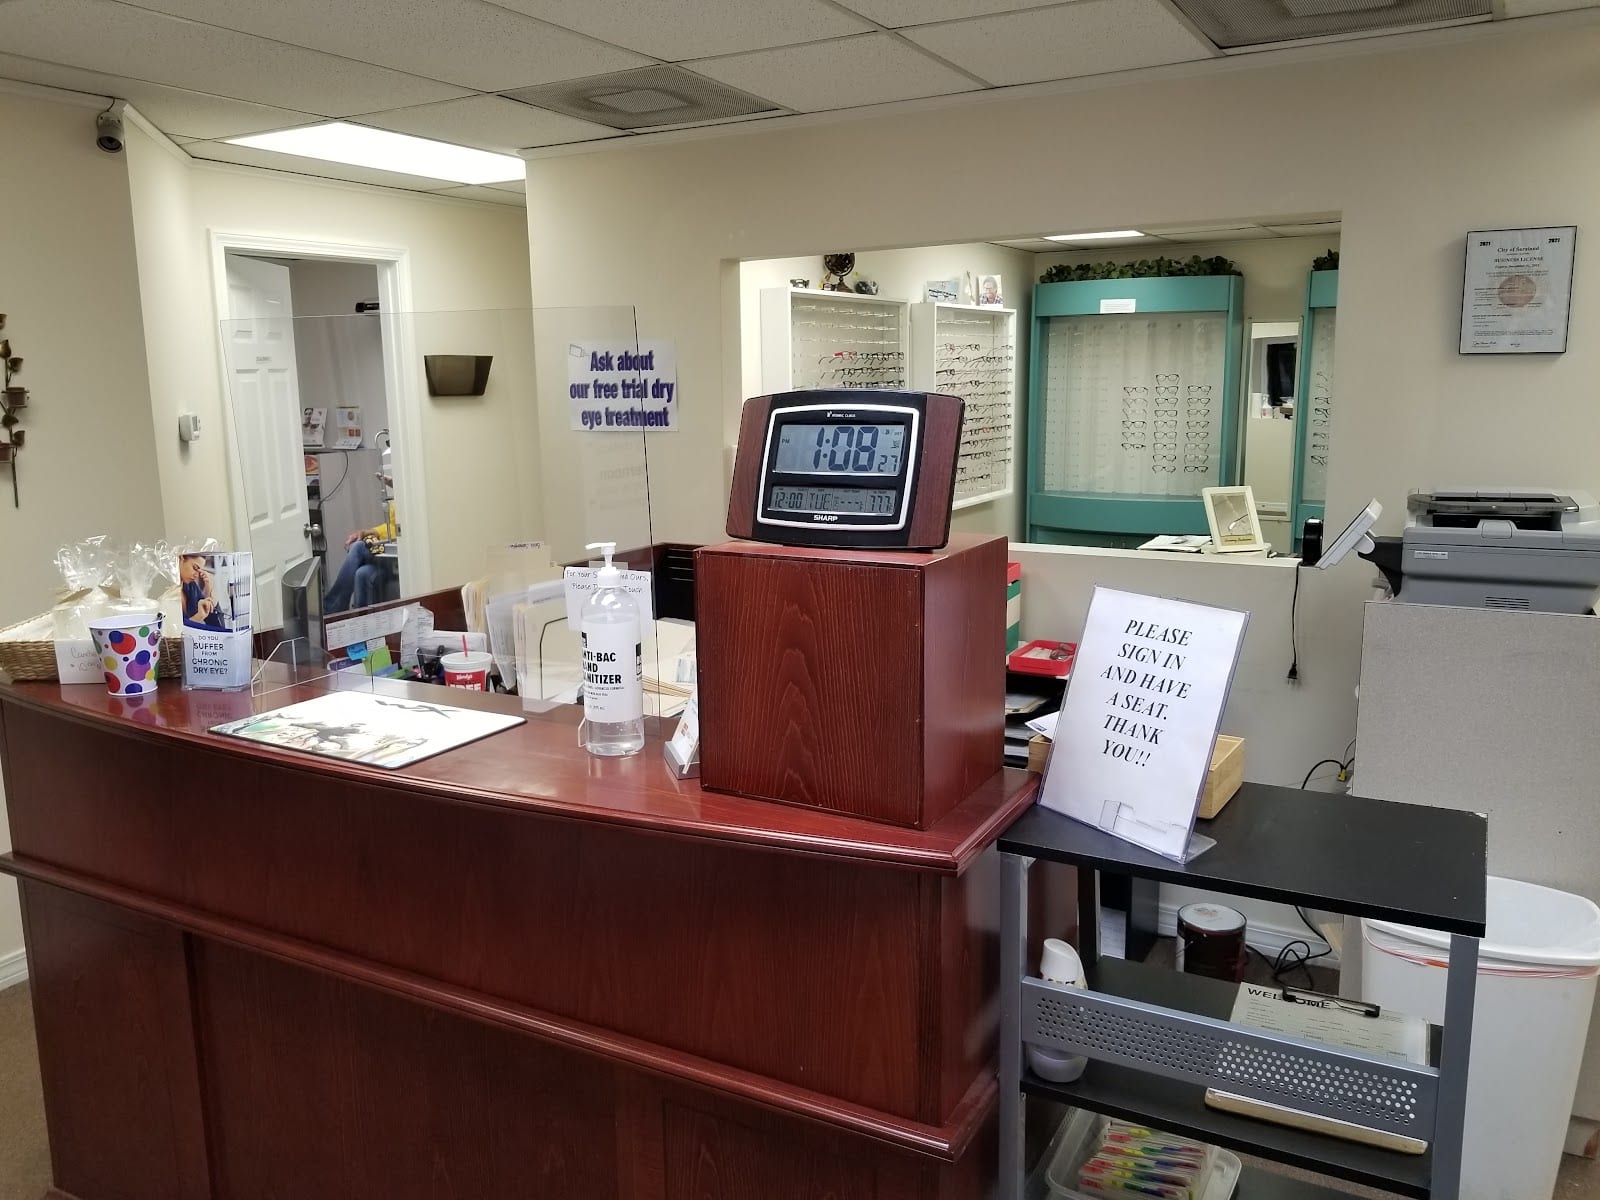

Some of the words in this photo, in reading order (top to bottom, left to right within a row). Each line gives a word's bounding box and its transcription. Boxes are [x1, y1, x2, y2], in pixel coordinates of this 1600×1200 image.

[590, 350, 614, 371] Ask
[617, 350, 655, 371] about
[569, 383, 590, 399] our
[593, 378, 618, 399] free
[621, 378, 648, 399] trial
[651, 378, 674, 403] dry
[581, 409, 602, 430] eye
[604, 406, 670, 427] treatment
[813, 426, 879, 472] 1:08
[808, 493, 831, 510] TUE
[813, 514, 838, 522] SHARP
[1124, 619, 1193, 647] PLEASE
[193, 642, 224, 650] SUFFER
[1117, 642, 1162, 665] SIGN
[1162, 653, 1187, 671] IN
[191, 658, 228, 666] CHRONIC
[193, 666, 208, 674] DRY
[209, 667, 228, 675] EYE?
[584, 673, 622, 685] NITIZER
[1100, 664, 1137, 684] AND
[1139, 673, 1192, 699] HAVE
[1105, 691, 1119, 706] A
[1121, 694, 1169, 720] SEAT.
[1103, 714, 1164, 745] THANK
[1102, 739, 1151, 767] YOU!!
[1248, 988, 1330, 1008] WELOME
